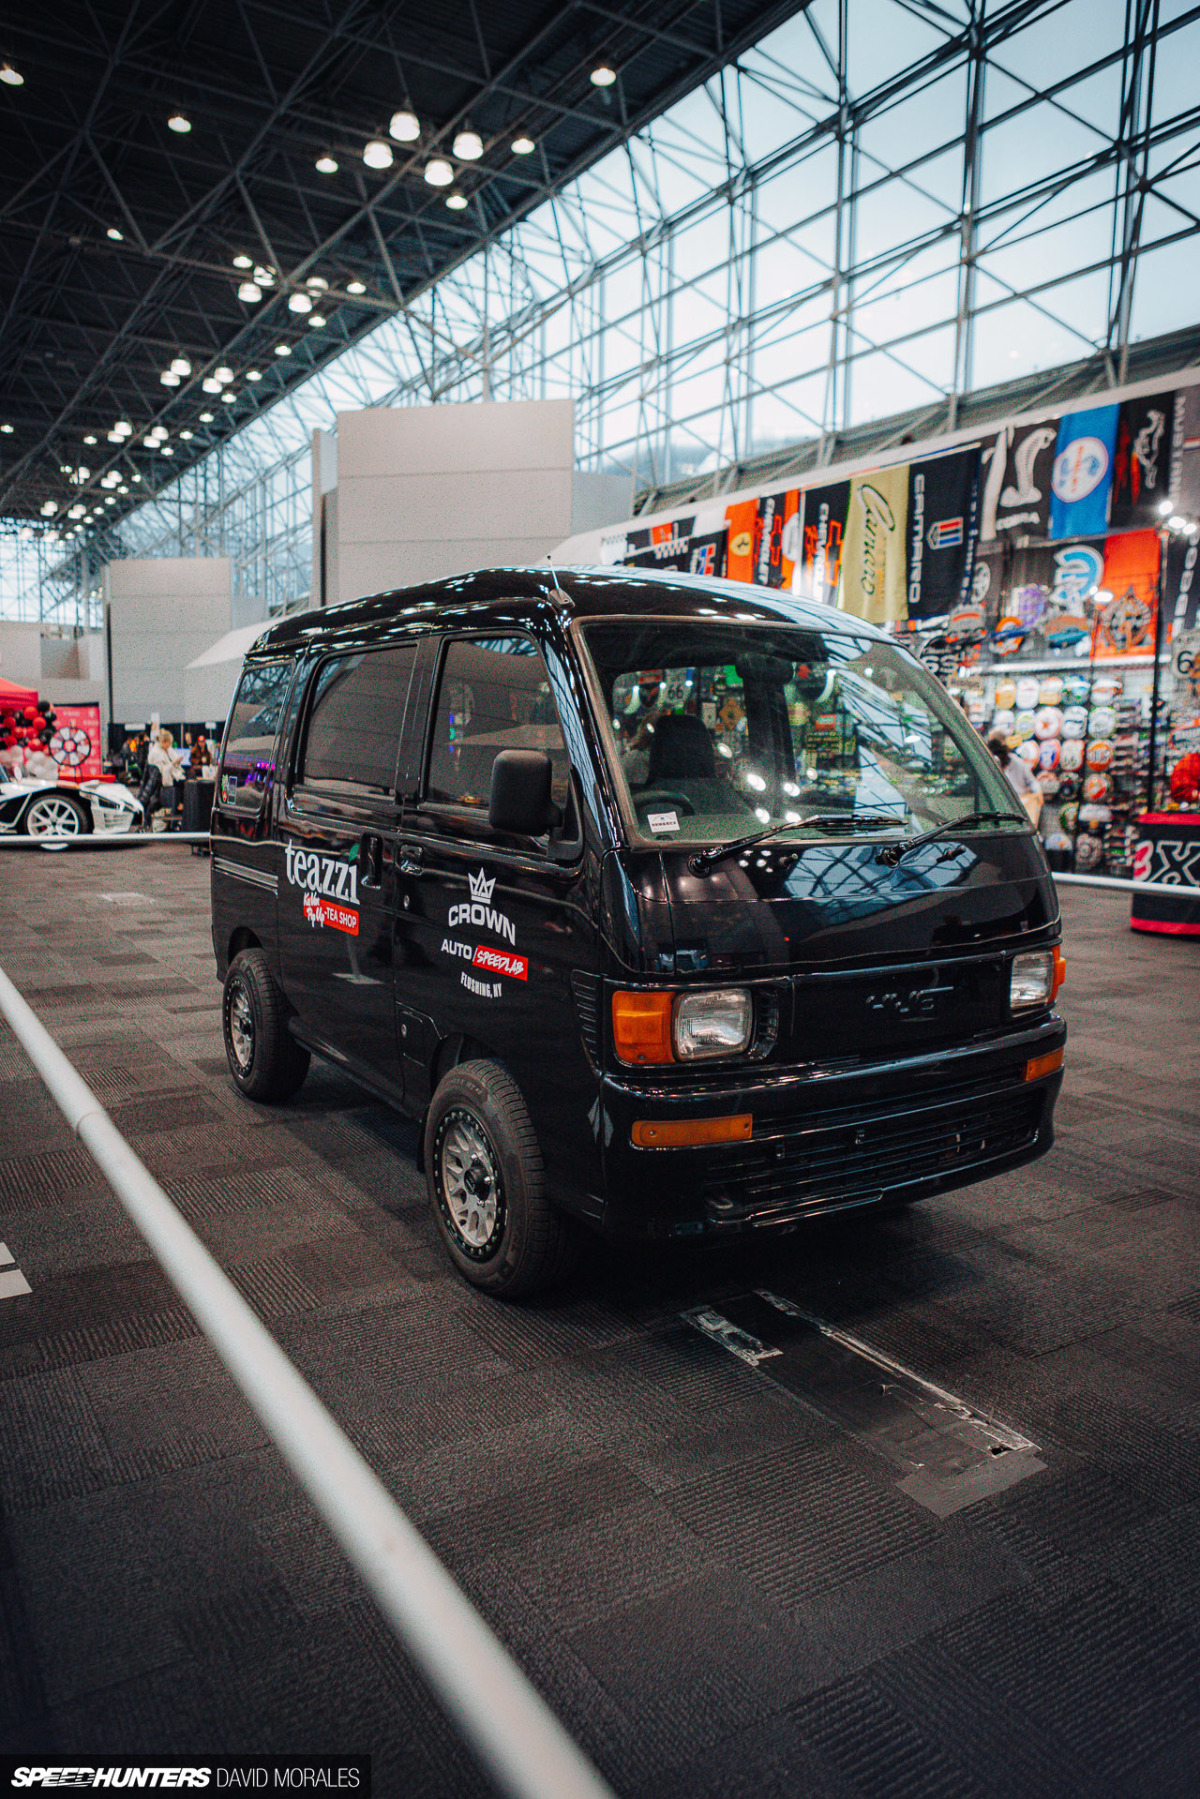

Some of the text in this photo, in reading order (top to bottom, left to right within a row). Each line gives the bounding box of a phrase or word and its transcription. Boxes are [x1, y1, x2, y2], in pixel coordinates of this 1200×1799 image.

[1167, 396, 1187, 506] MUSTAN
[813, 503, 830, 604] CHEVROL
[857, 484, 895, 595] Camaro
[909, 474, 925, 603] CAMARO
[339, 911, 357, 929] SHOP
[441, 938, 525, 976] AUTO SPEEDLAB
[448, 903, 516, 946] CROWN
